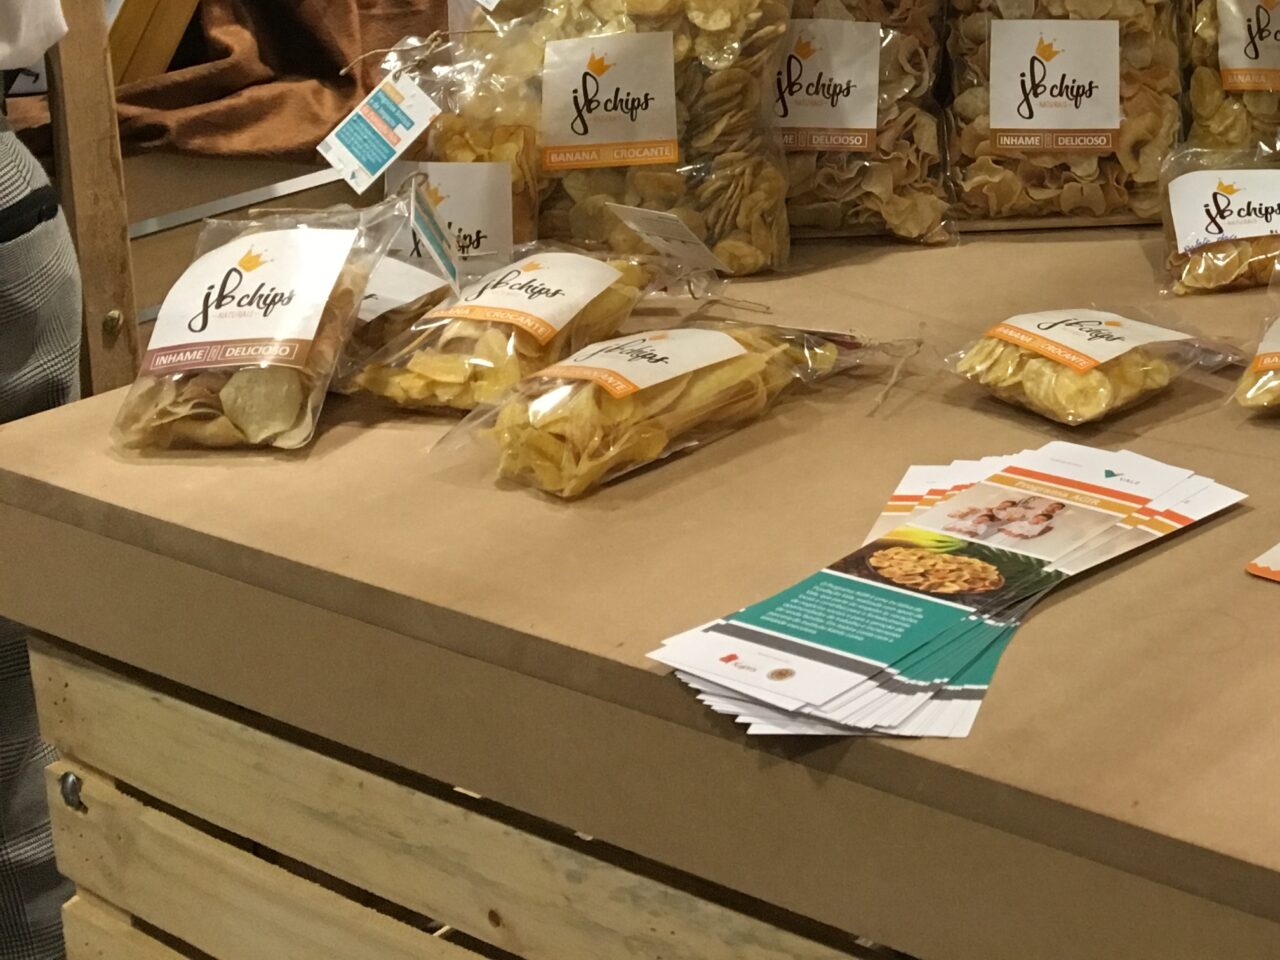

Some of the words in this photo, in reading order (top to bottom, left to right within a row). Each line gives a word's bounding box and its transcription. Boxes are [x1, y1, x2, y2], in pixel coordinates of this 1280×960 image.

[1244, 5, 1271, 59] jb
[571, 72, 600, 135] jb
[604, 87, 655, 121] chips
[806, 72, 857, 107] chips
[1017, 56, 1047, 120] jb
[1050, 73, 1099, 109] chips
[551, 151, 598, 162] BANANA
[614, 147, 670, 159] CROCANTE
[812, 135, 862, 145] DELICIOSO
[1000, 137, 1040, 145] INHAME
[1058, 137, 1106, 145] DELICIOSO
[1203, 192, 1233, 234] jb
[188, 267, 243, 333] jb
[237, 283, 295, 317] chips
[509, 278, 565, 299] chips
[156, 351, 204, 365] INHAME
[225, 345, 290, 357] DELICIOSO
